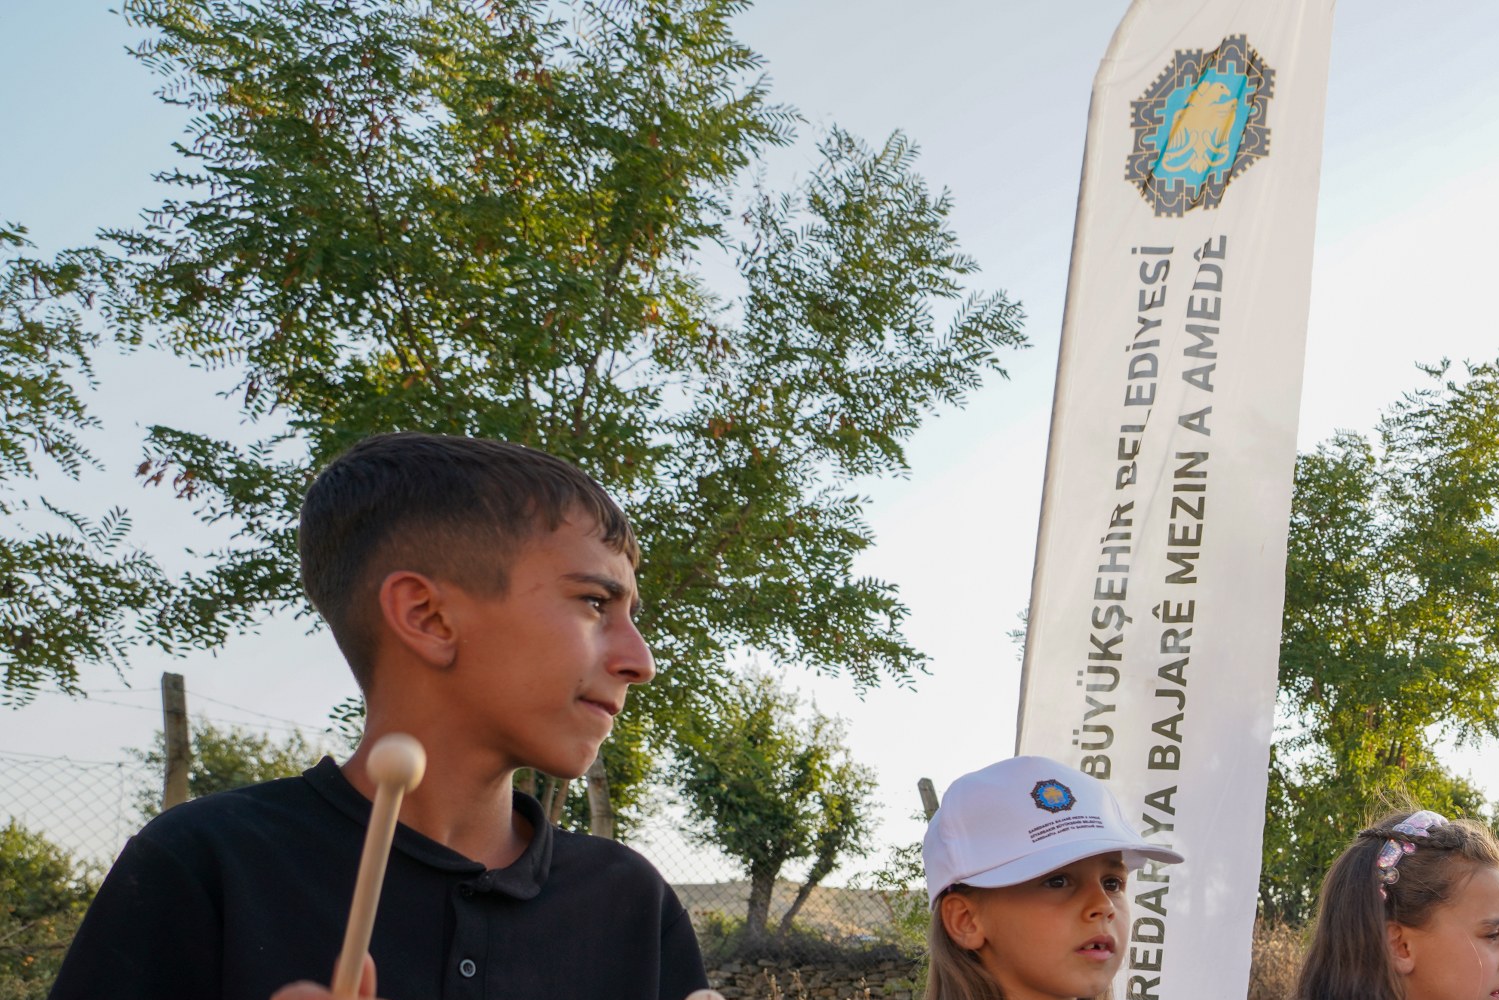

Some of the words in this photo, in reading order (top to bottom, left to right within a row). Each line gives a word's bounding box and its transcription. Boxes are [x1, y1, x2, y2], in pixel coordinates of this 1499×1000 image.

[1182, 235, 1227, 393] AMEDÊ
[1178, 406, 1213, 436] A
[1072, 500, 1134, 780] BÜYÜKŞEHİR
[1115, 246, 1175, 490] BELEDİYESİ
[1165, 452, 1209, 584] MEZIN
[1148, 600, 1195, 770] BAJARÊ
